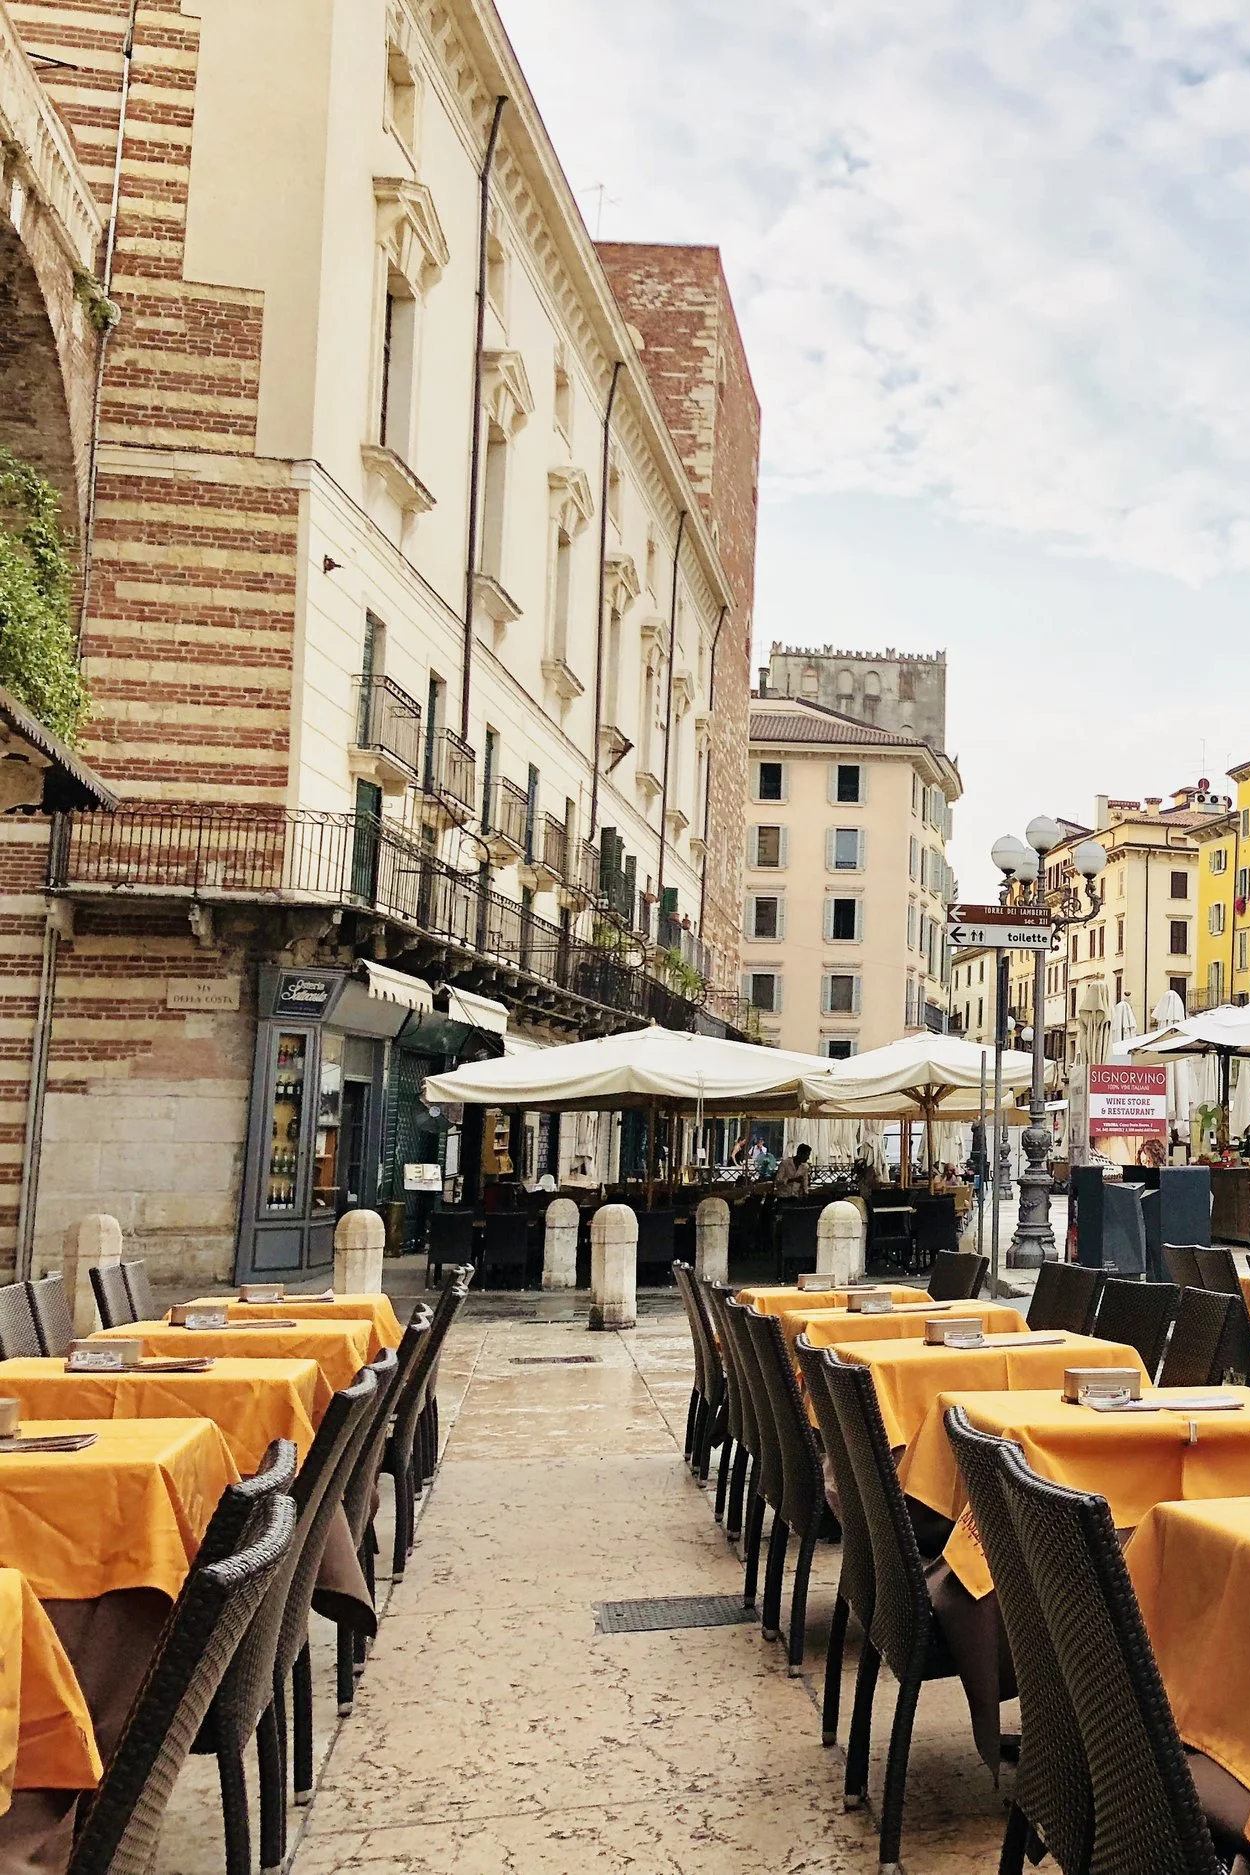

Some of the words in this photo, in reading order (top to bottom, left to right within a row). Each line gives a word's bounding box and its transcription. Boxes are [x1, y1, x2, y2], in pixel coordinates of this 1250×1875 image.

[984, 907, 1003, 915] TORRE
[1020, 909, 1049, 917] LAMBERTI
[1007, 932, 1048, 943] toilette
[205, 995, 233, 1004] COSTA
[1091, 1070, 1166, 1085] SIGNORVINO
[1105, 1097, 1126, 1106] WINE
[1127, 1098, 1151, 1106] STORE
[1101, 1107, 1106, 1115] &
[1107, 1107, 1156, 1116] RESTAURANT
